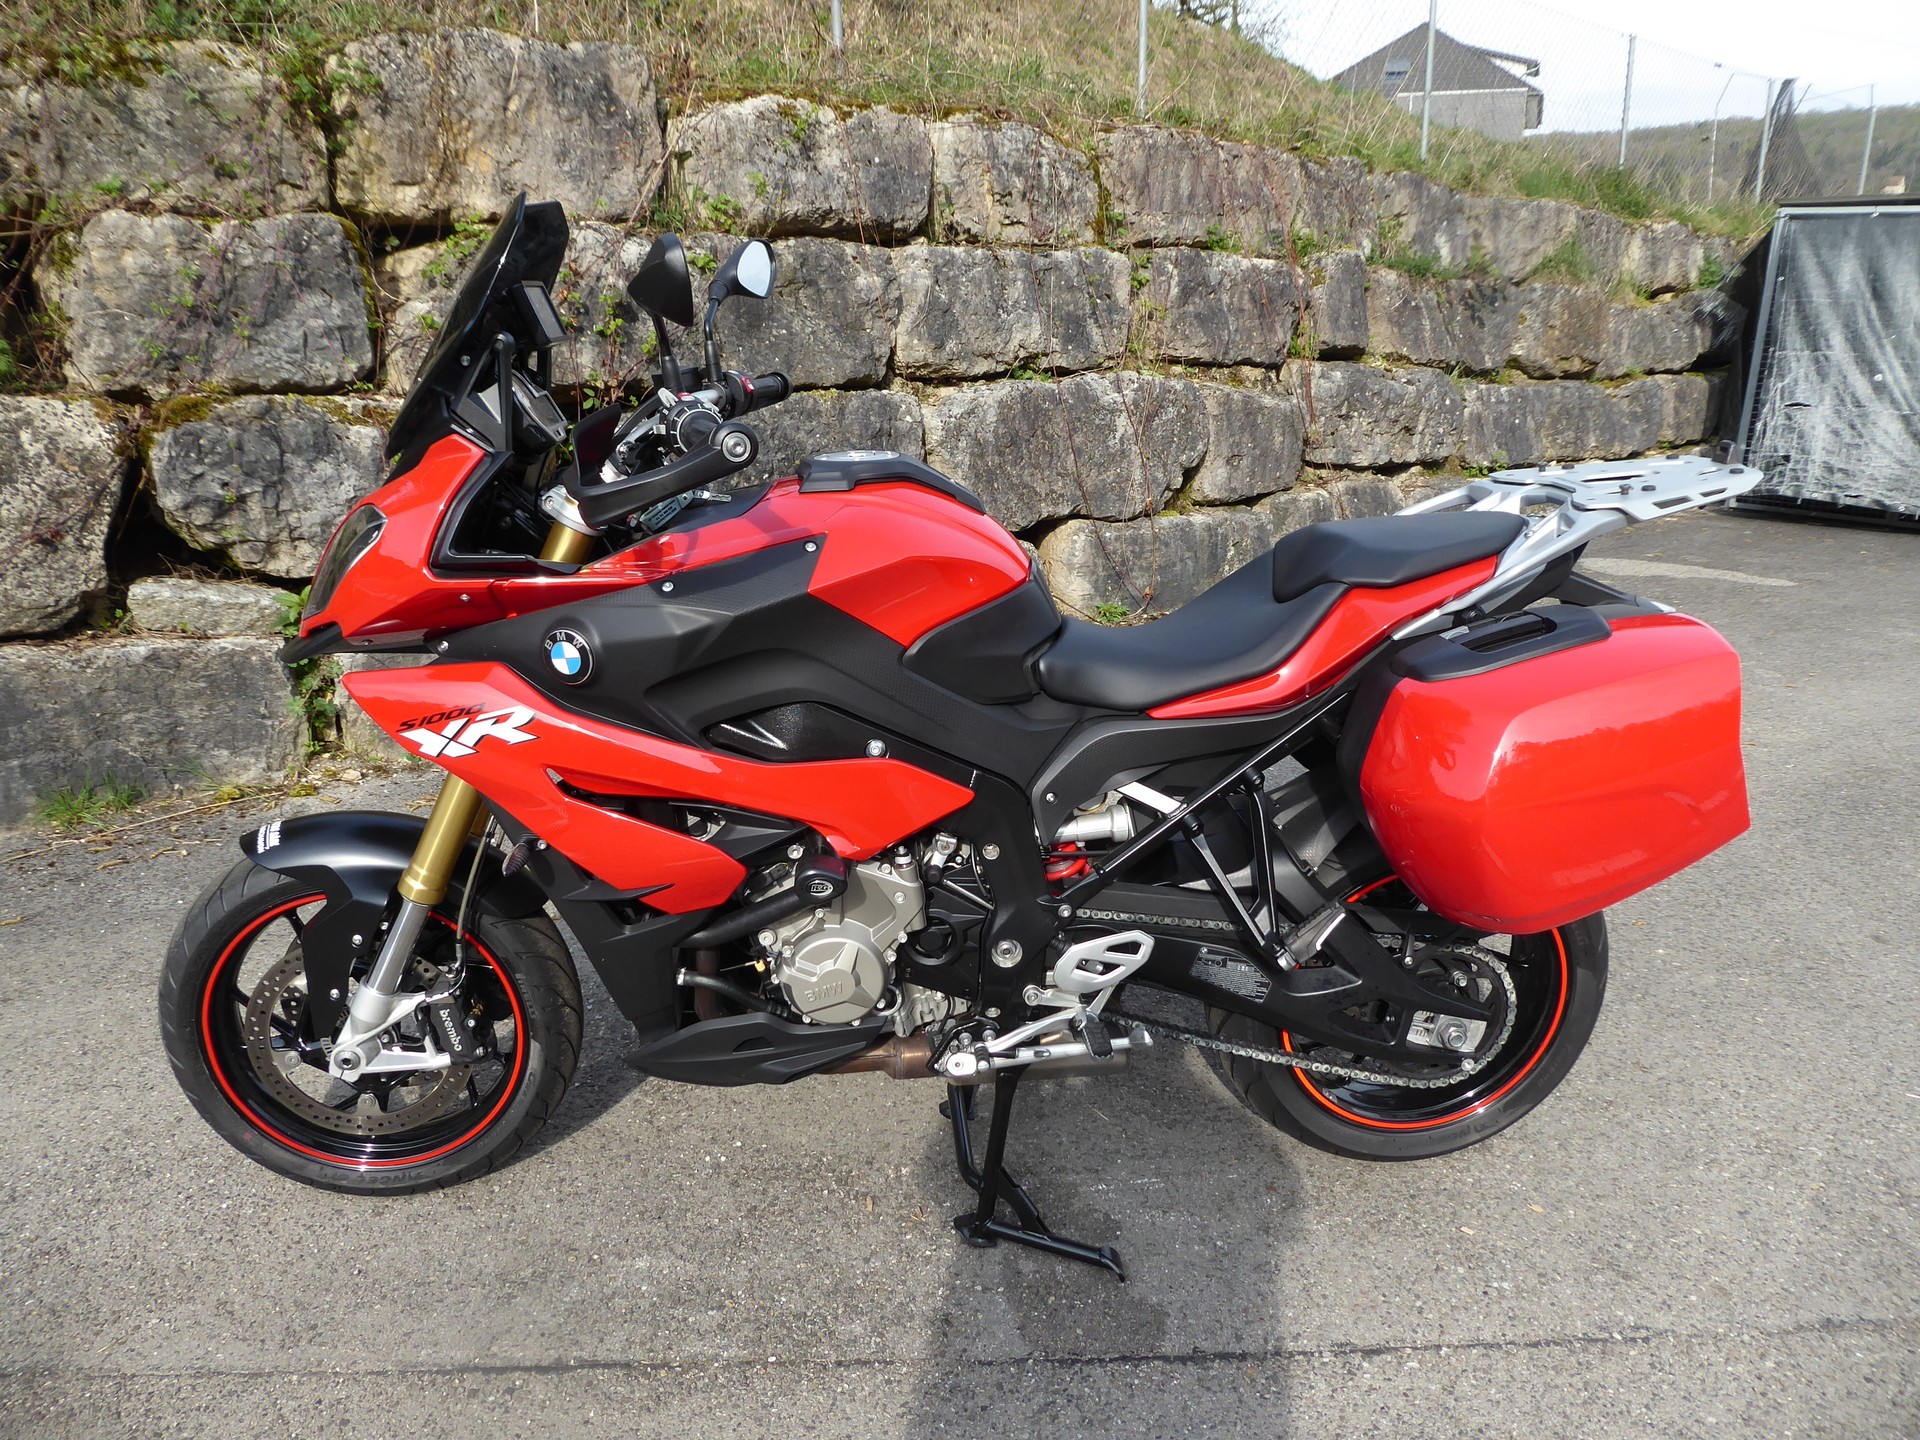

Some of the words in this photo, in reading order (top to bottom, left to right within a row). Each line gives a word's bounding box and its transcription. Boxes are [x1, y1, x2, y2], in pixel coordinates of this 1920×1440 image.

[544, 631, 584, 650] BMW
[396, 702, 486, 733] S1000
[399, 705, 541, 758] XR
[804, 980, 844, 1003] BMW
[439, 1008, 463, 1051] brembo
